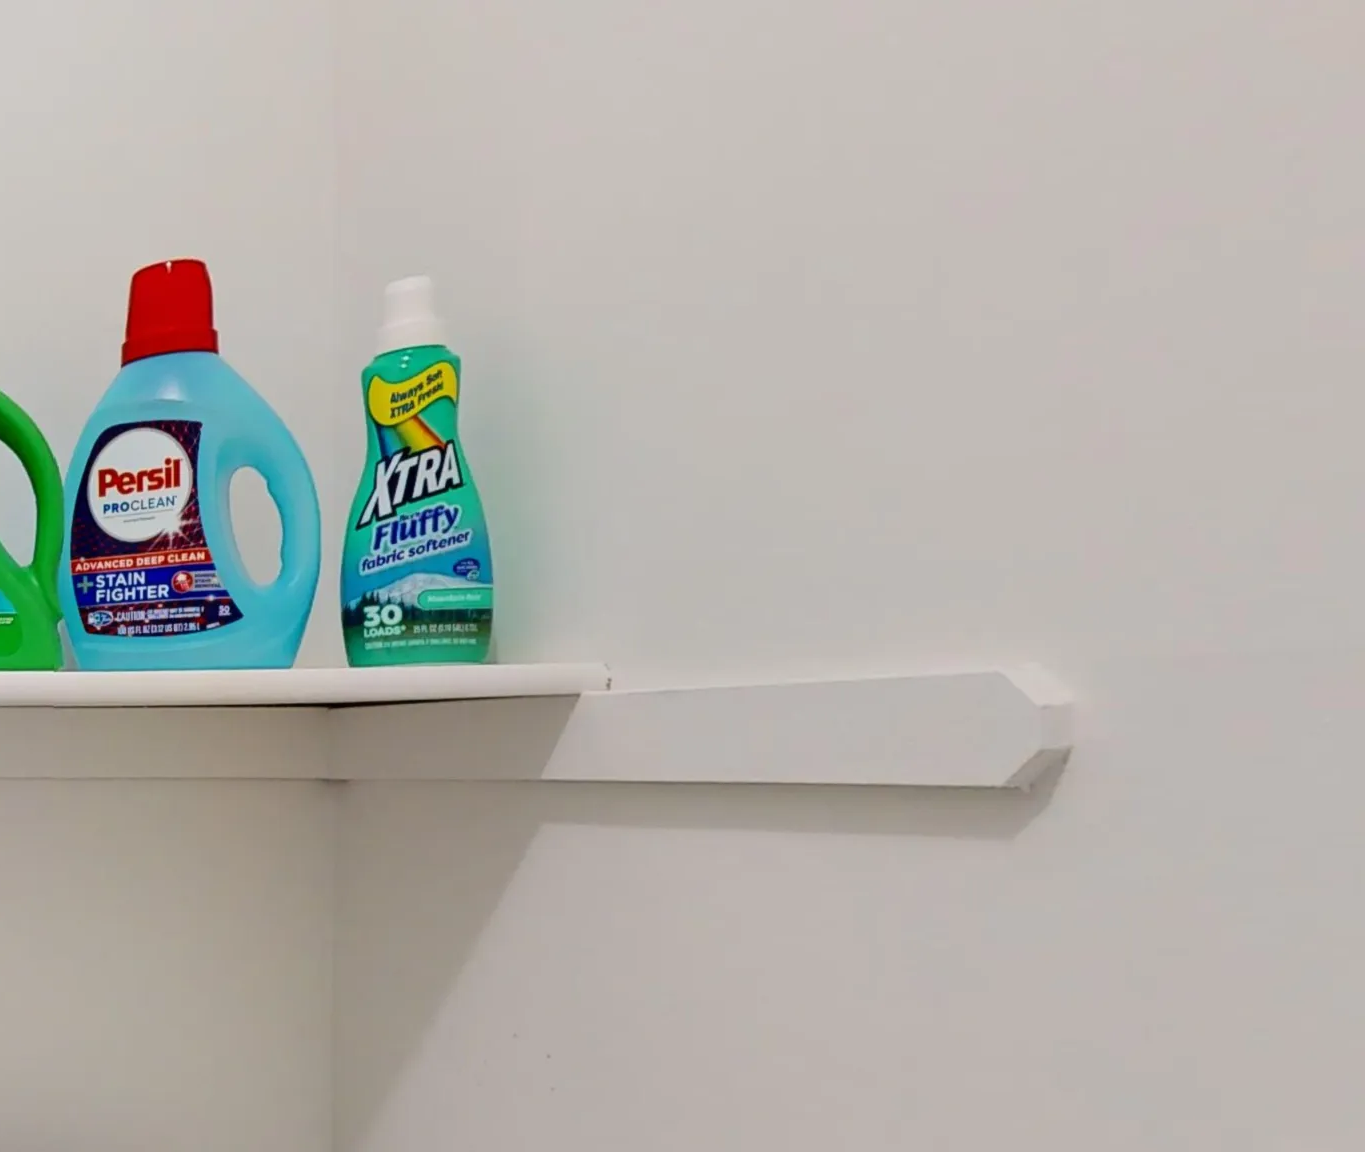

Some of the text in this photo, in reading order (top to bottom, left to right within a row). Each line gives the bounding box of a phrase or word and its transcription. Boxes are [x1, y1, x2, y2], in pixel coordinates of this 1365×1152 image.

[389, 369, 444, 405] Always Soft
[389, 400, 416, 419] XTRA
[97, 457, 182, 498] Persil
[358, 441, 462, 527] XTRA
[102, 496, 176, 514] PROCLEAN
[372, 505, 459, 551] Fluffy
[75, 552, 206, 572] ADVANCED DEEP CLEAN
[361, 531, 470, 572] fabric softener
[95, 571, 146, 588] STAIN
[95, 584, 169, 603] FIGHTER
[363, 604, 403, 627] 30
